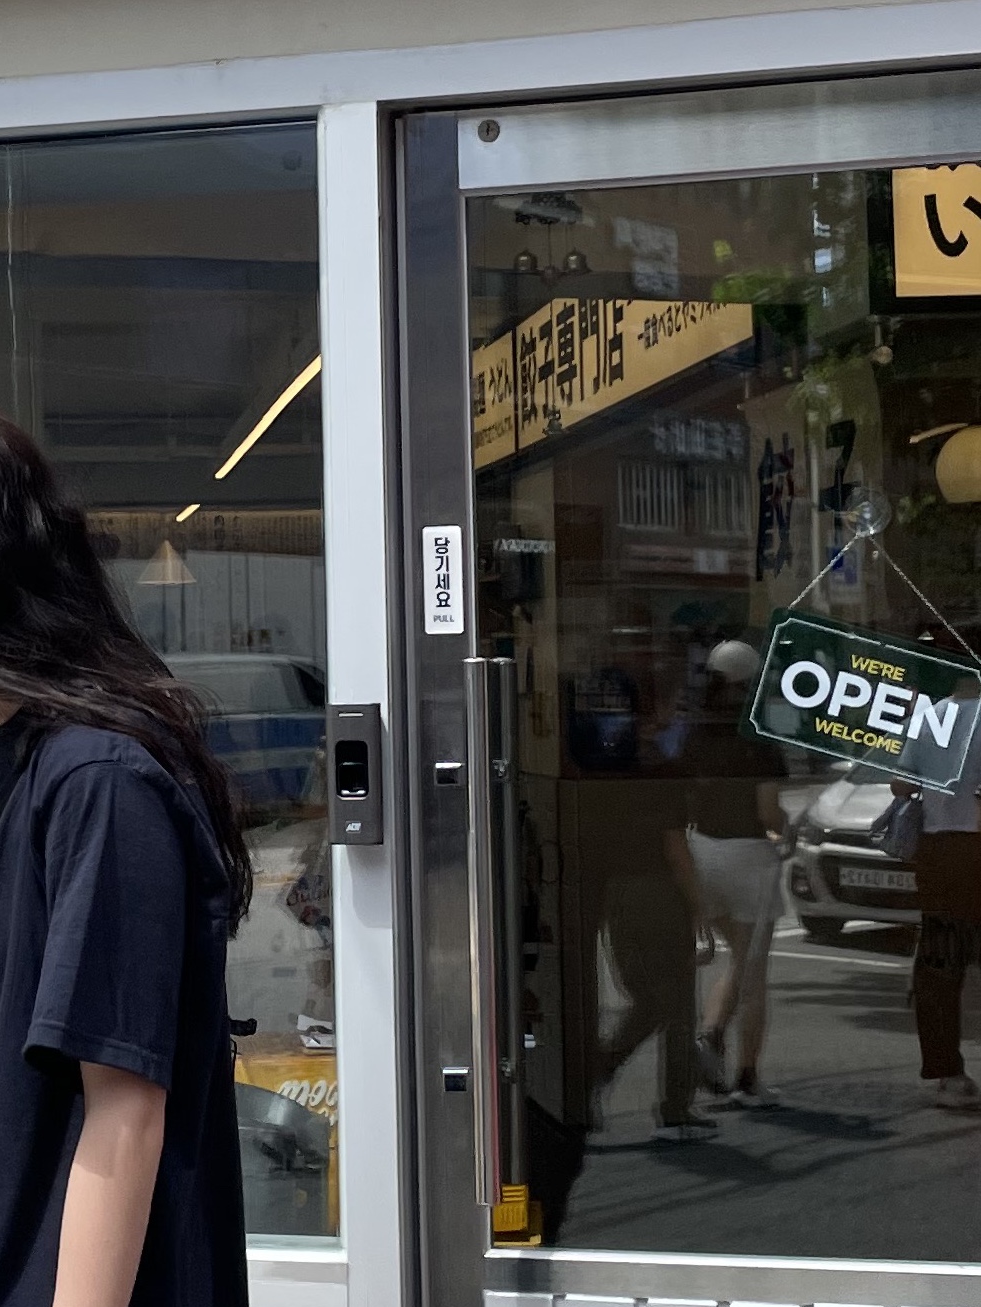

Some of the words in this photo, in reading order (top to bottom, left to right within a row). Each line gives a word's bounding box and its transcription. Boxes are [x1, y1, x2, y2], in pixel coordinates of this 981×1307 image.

[434, 537, 451, 608] 당기세요
[433, 614, 454, 623] PULL
[851, 654, 906, 682] WE'RE
[781, 660, 960, 749] OPEN
[815, 717, 904, 755] WELCOME
